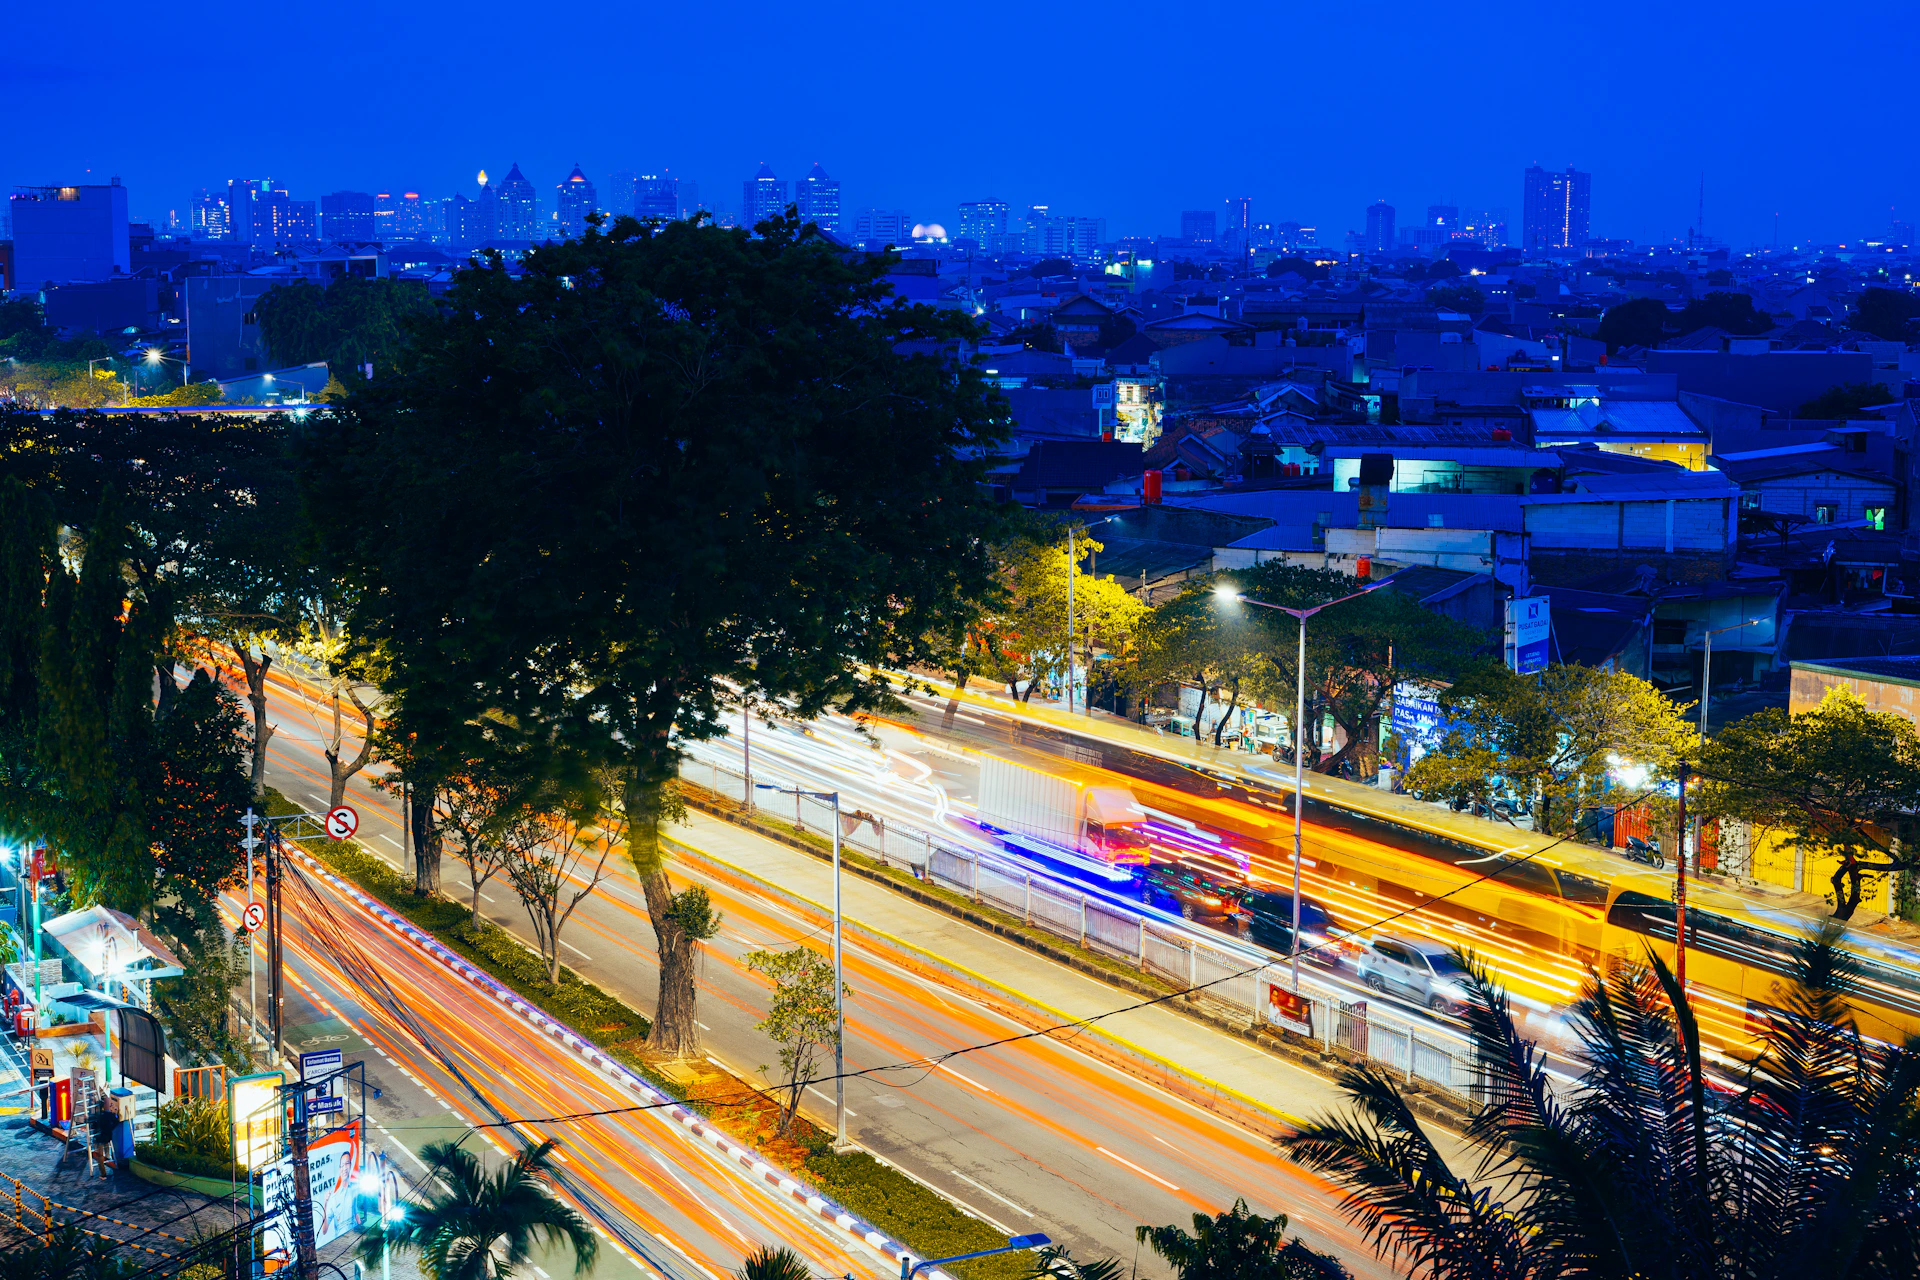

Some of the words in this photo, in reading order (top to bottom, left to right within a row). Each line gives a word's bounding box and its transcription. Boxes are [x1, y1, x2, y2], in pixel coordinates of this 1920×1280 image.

[1518, 621, 1533, 631] PUSAT
[1077, 754, 1103, 768] GRATIS
[312, 1177, 336, 1196] KUAT!
